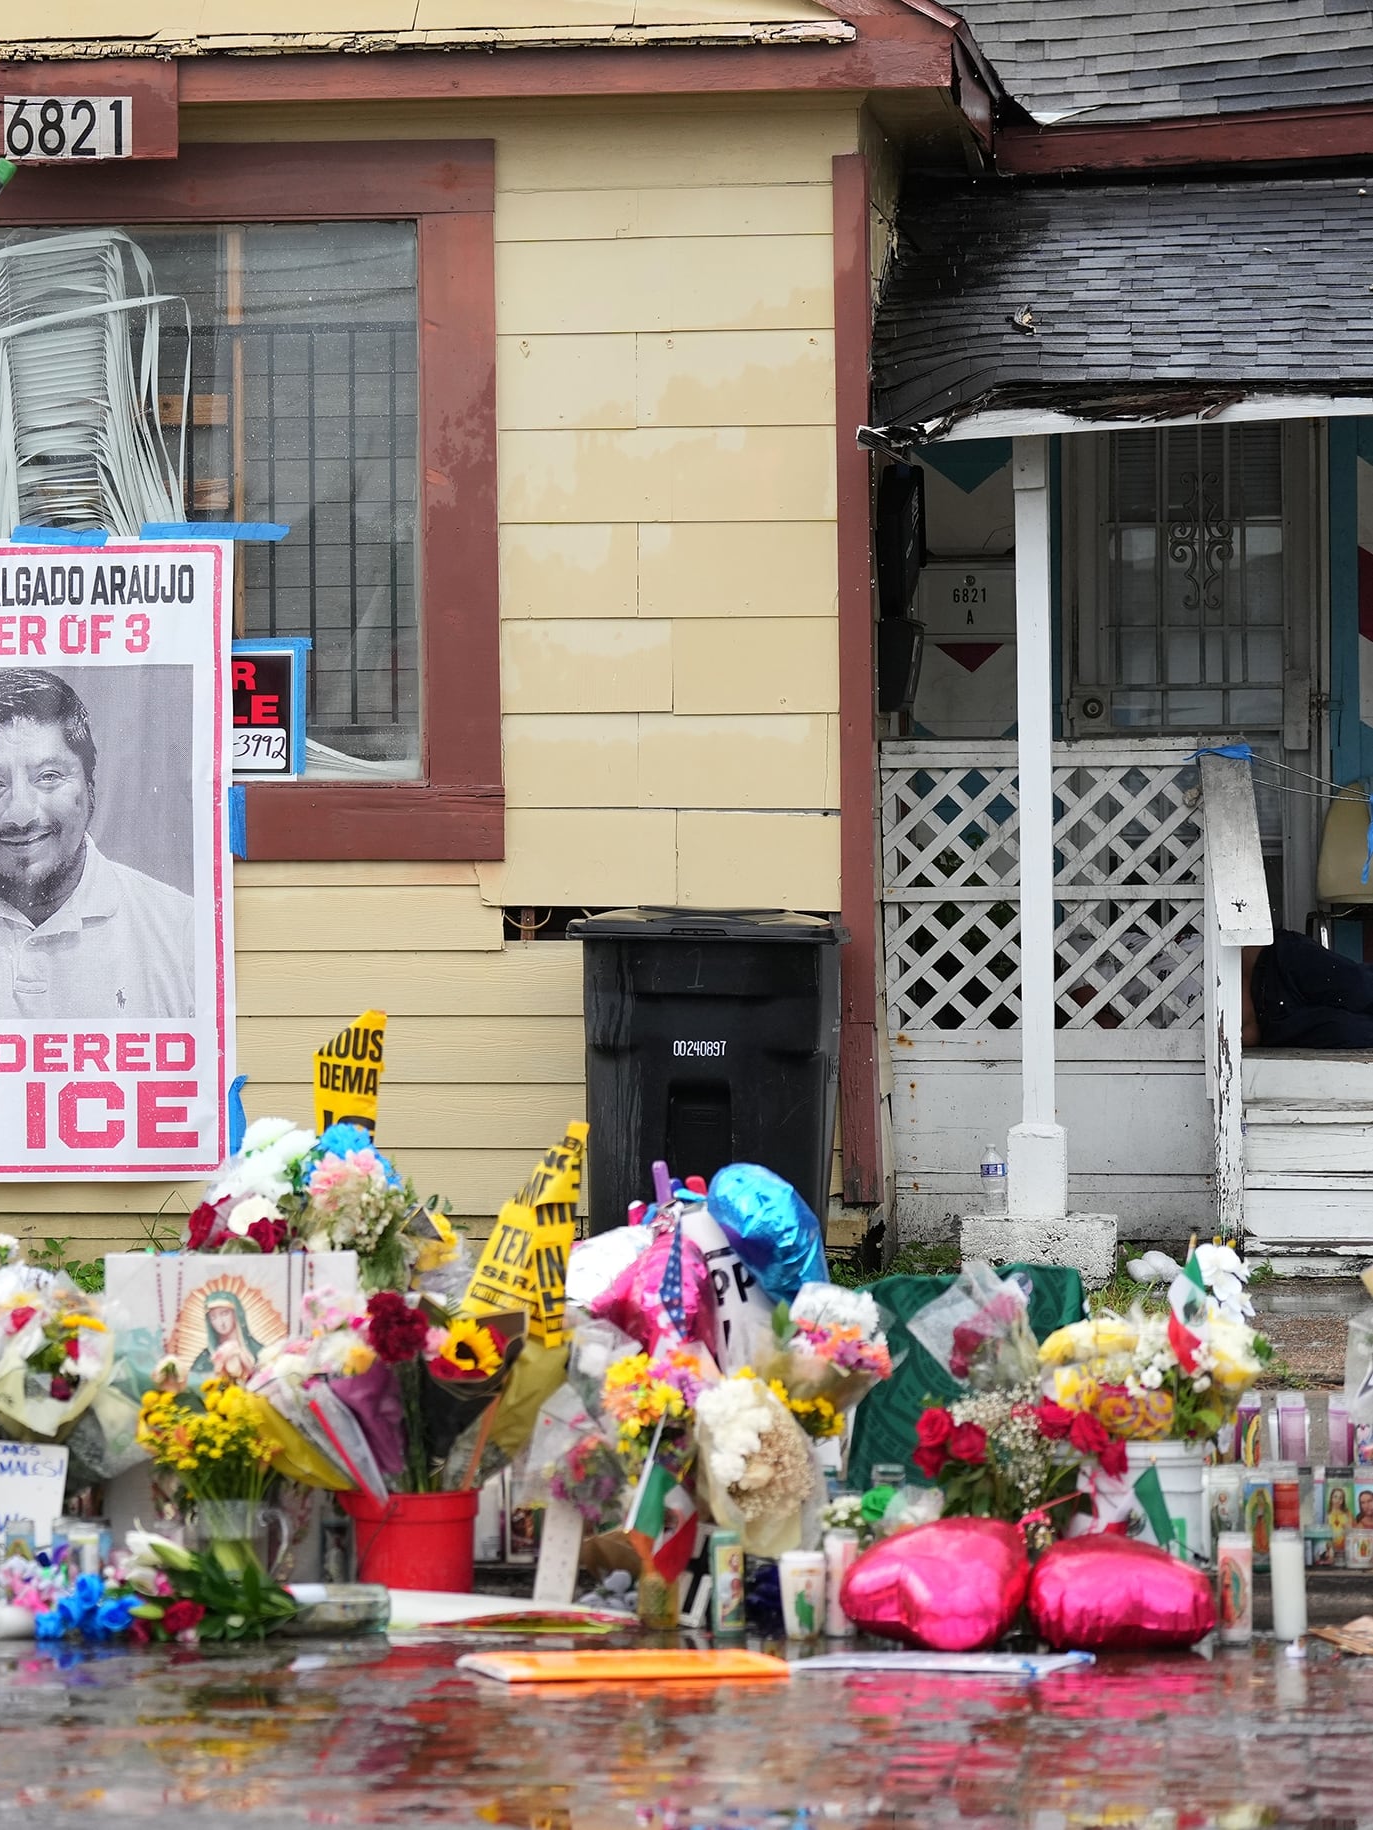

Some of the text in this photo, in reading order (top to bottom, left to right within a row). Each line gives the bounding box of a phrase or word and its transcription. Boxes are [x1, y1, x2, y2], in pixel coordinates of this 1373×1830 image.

[7, 99, 123, 157] 6821
[90, 563, 195, 606] ARAUJO
[952, 587, 987, 604] 6821
[59, 613, 114, 656] OF
[124, 612, 151, 654] 3
[966, 609, 974, 625] A
[673, 1040, 727, 1057] 00240897
[26, 1080, 199, 1150] ICE
